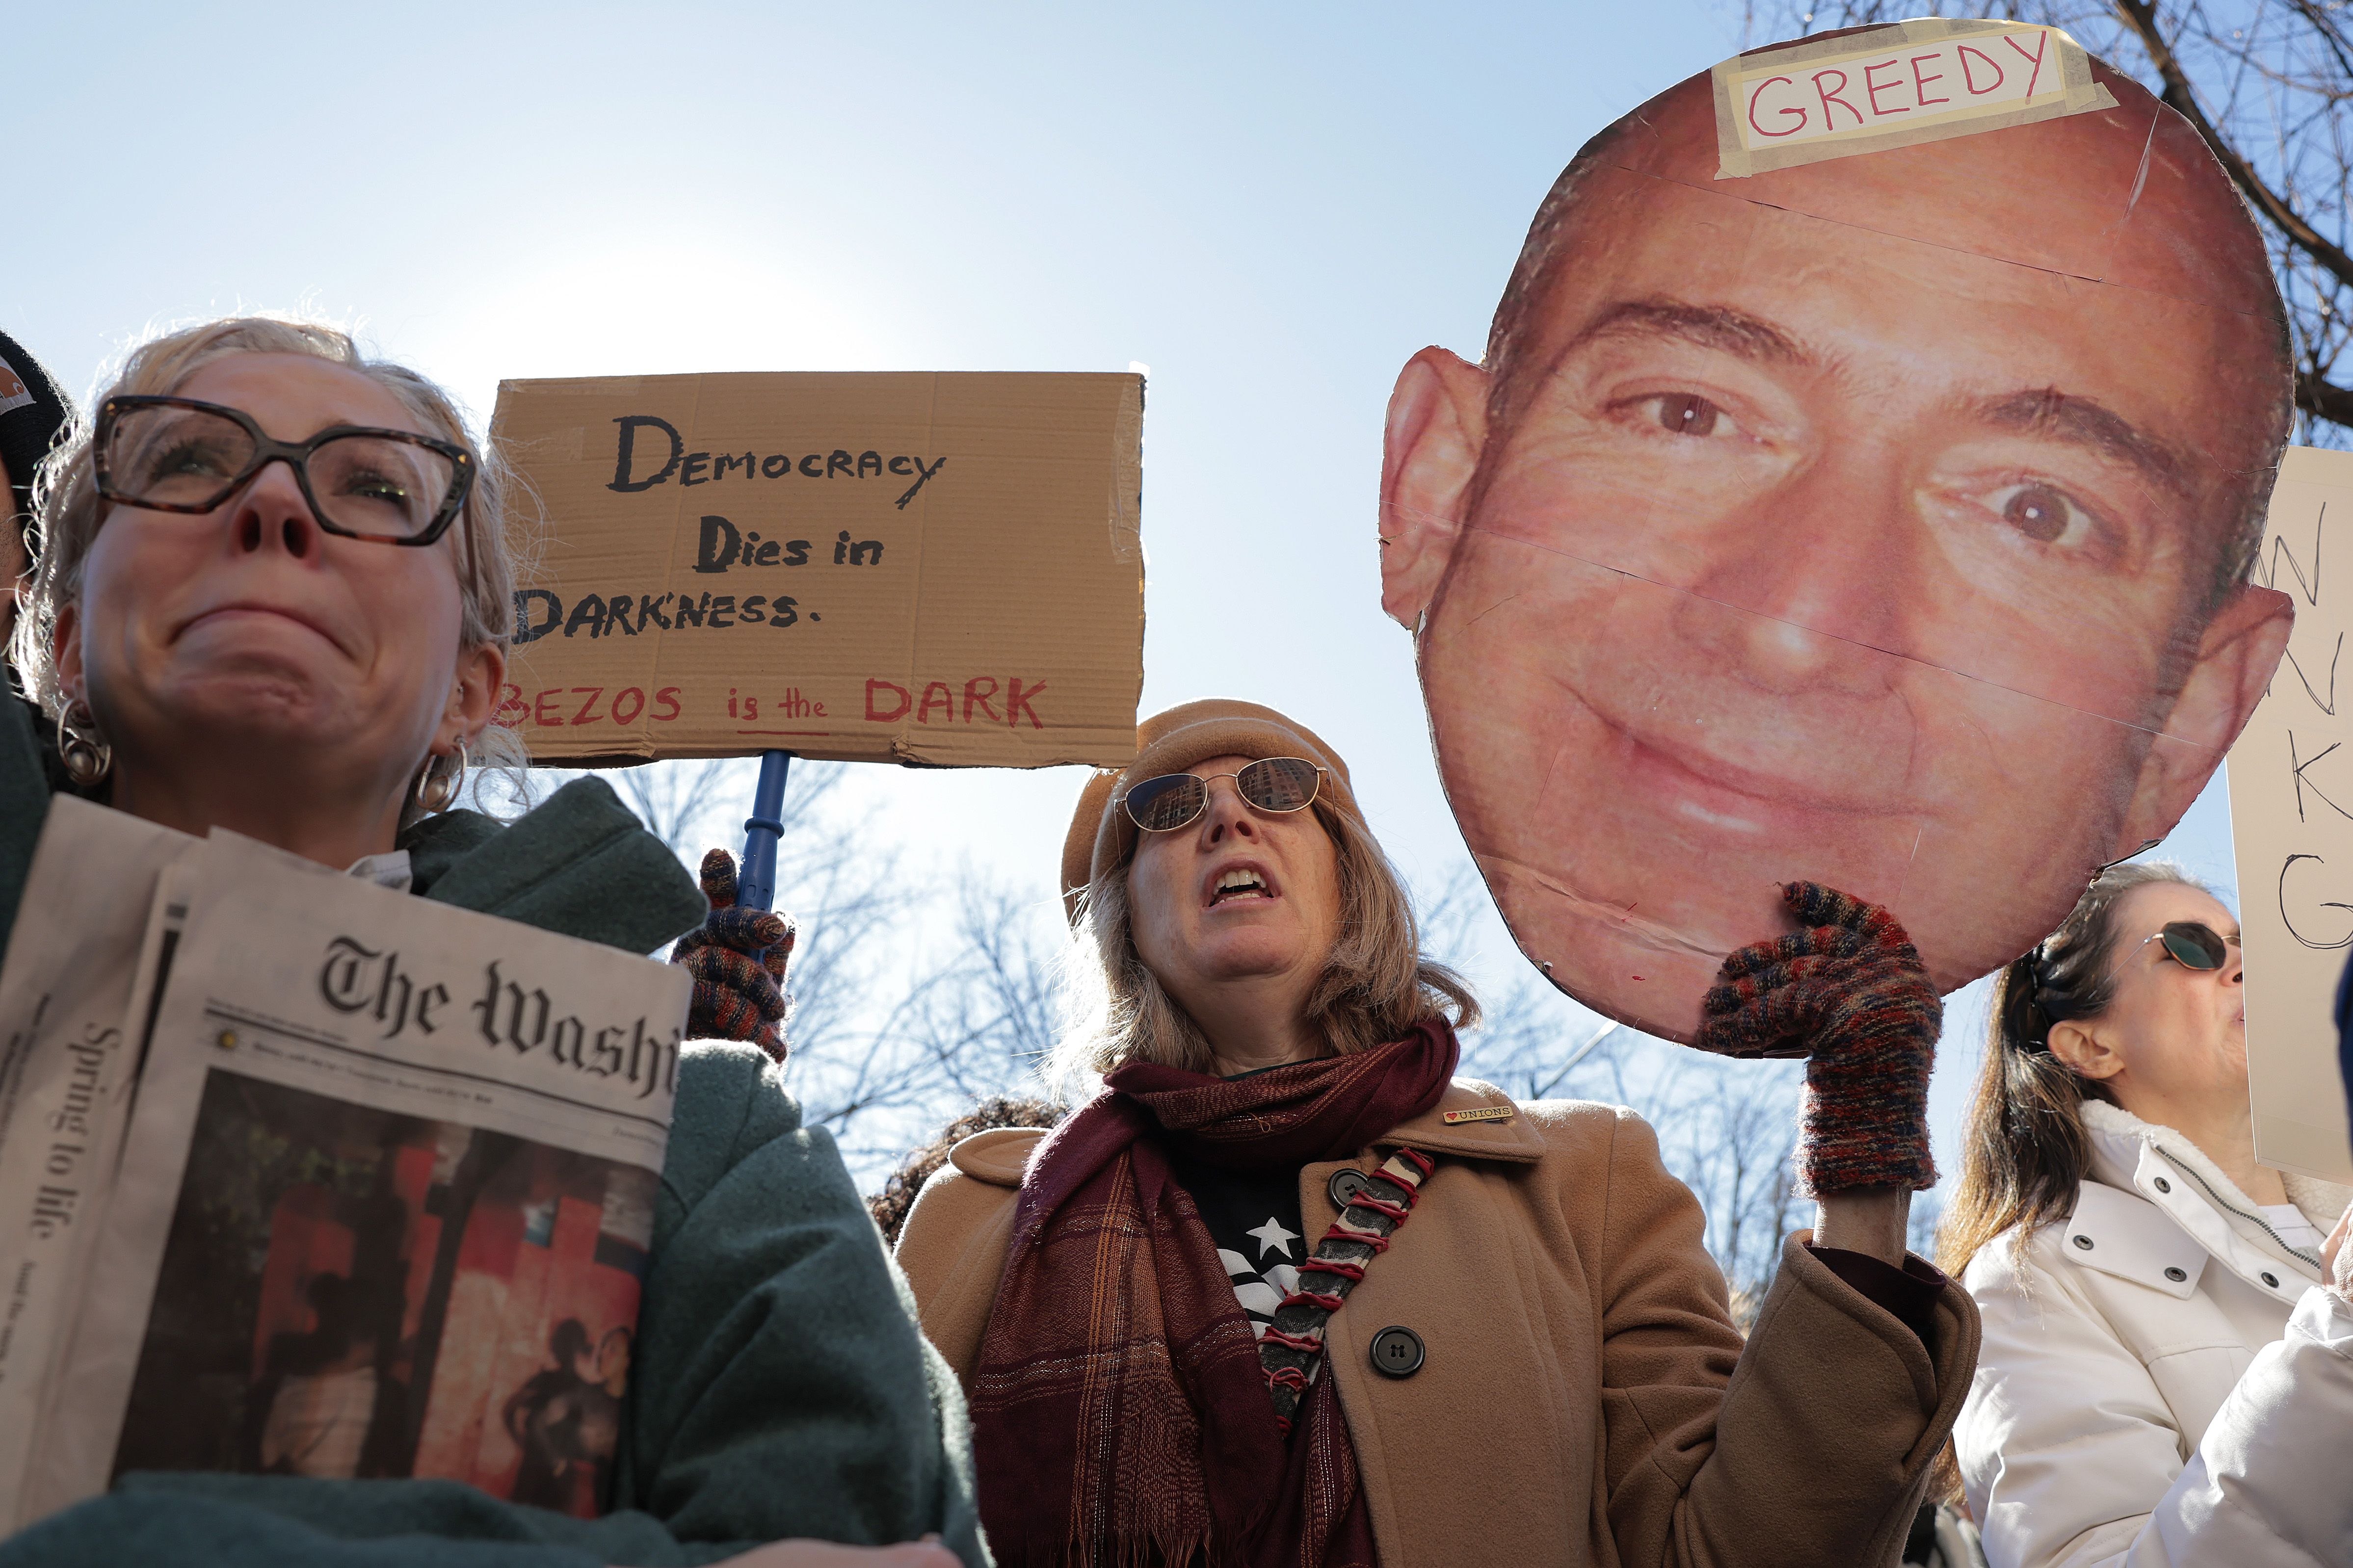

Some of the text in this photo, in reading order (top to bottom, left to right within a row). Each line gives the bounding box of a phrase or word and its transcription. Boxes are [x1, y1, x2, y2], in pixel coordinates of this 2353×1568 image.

[1749, 30, 2047, 136] GREEDY
[606, 415, 947, 510] DEMOCRACY
[692, 515, 884, 573] Dies in
[491, 677, 1047, 729] BEZOS is the DARK
[319, 935, 450, 1040] The
[45, 1021, 122, 1136] Spring
[1458, 1107, 1510, 1120] UNIONS
[46, 1143, 85, 1176] to
